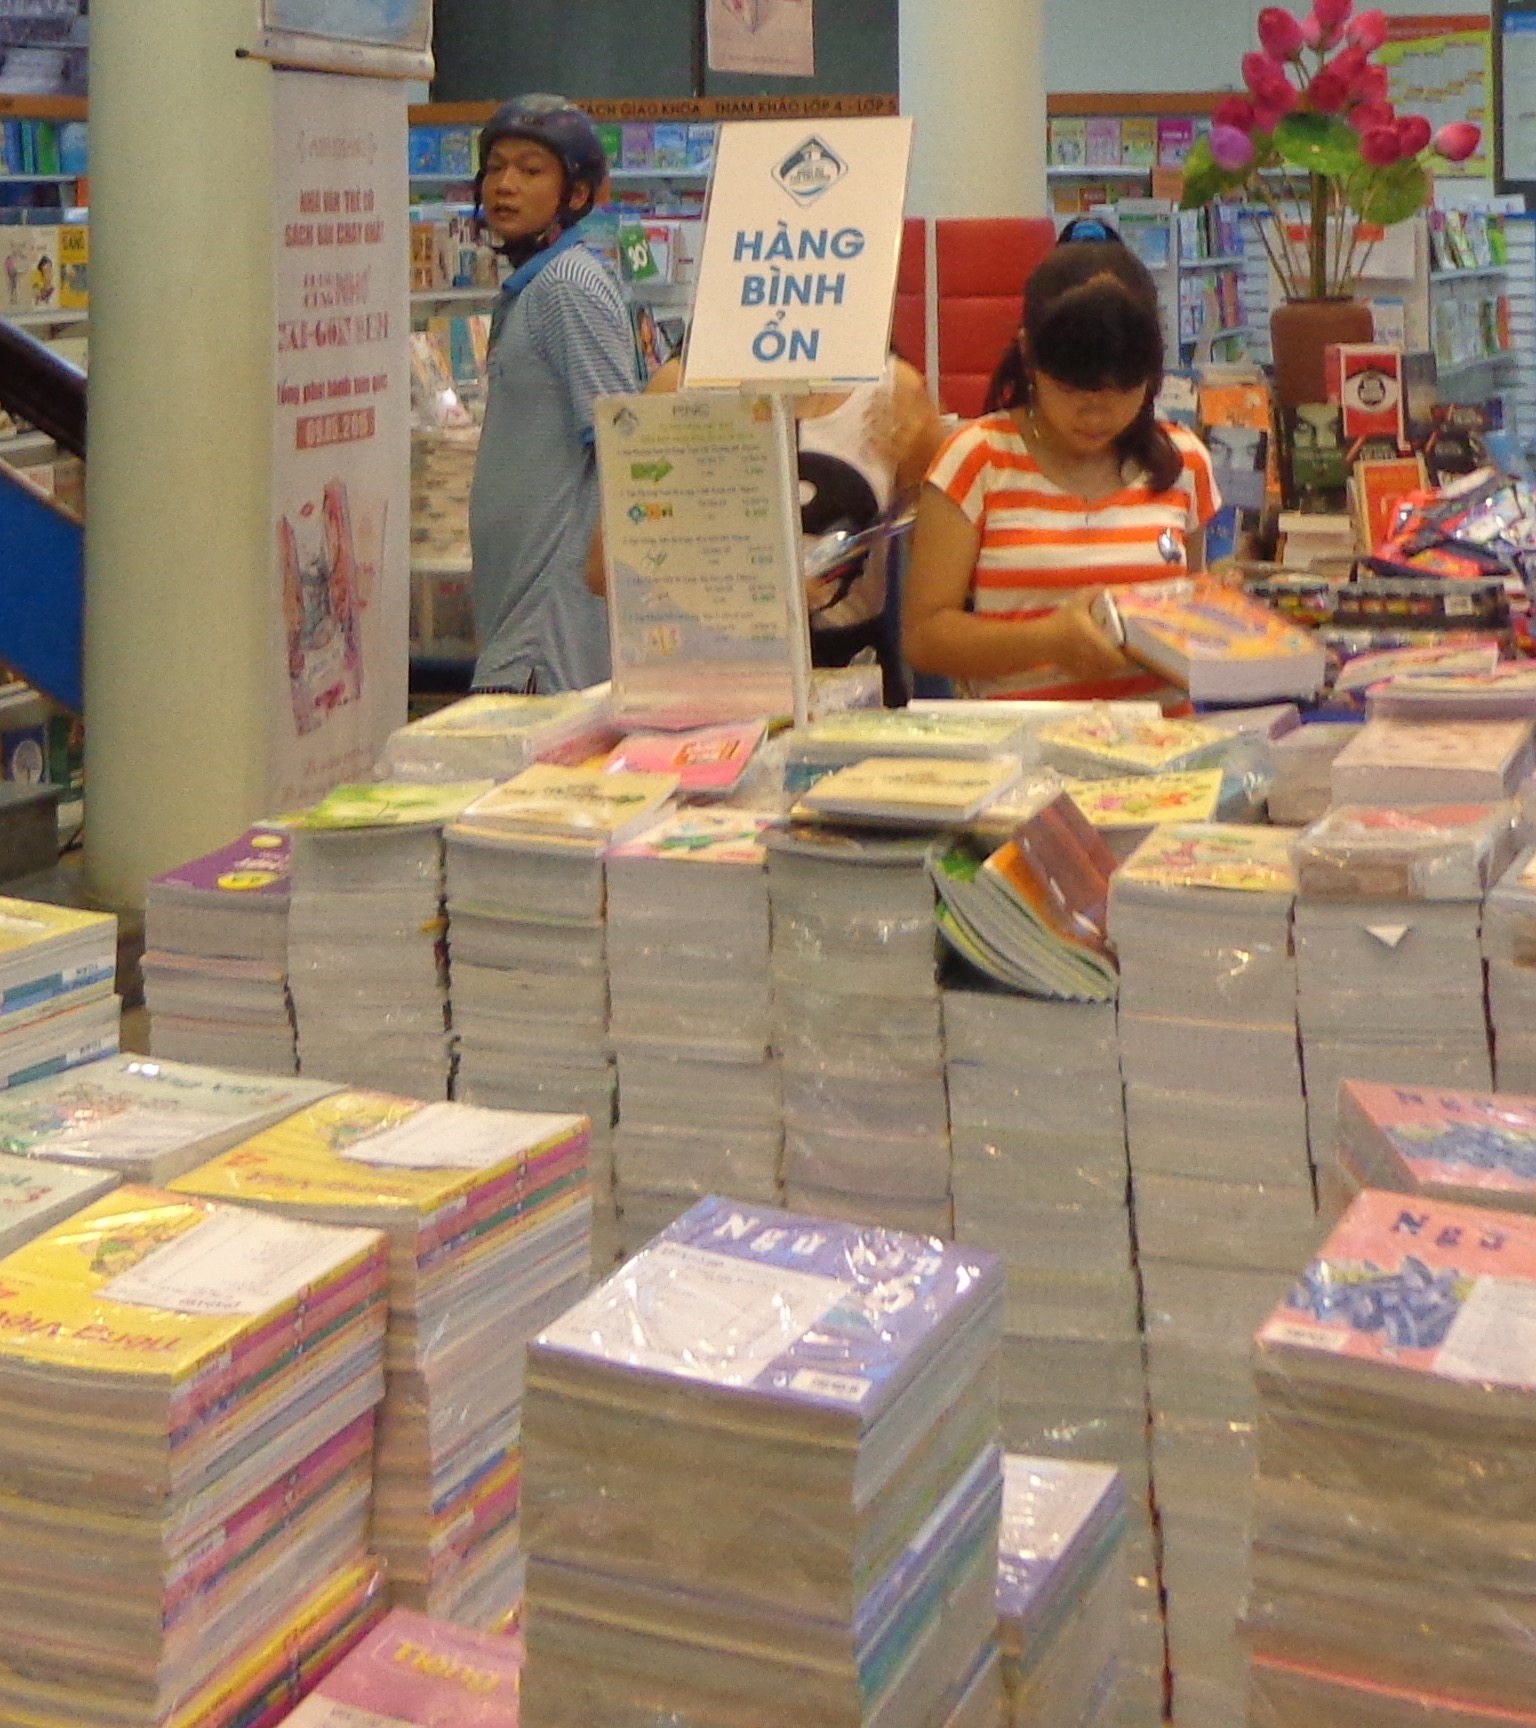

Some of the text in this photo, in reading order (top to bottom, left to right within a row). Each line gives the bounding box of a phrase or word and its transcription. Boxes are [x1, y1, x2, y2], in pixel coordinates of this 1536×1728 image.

[732, 219, 866, 263] HÀNG
[740, 266, 846, 307] BÌNH
[751, 309, 820, 363] ỔN
